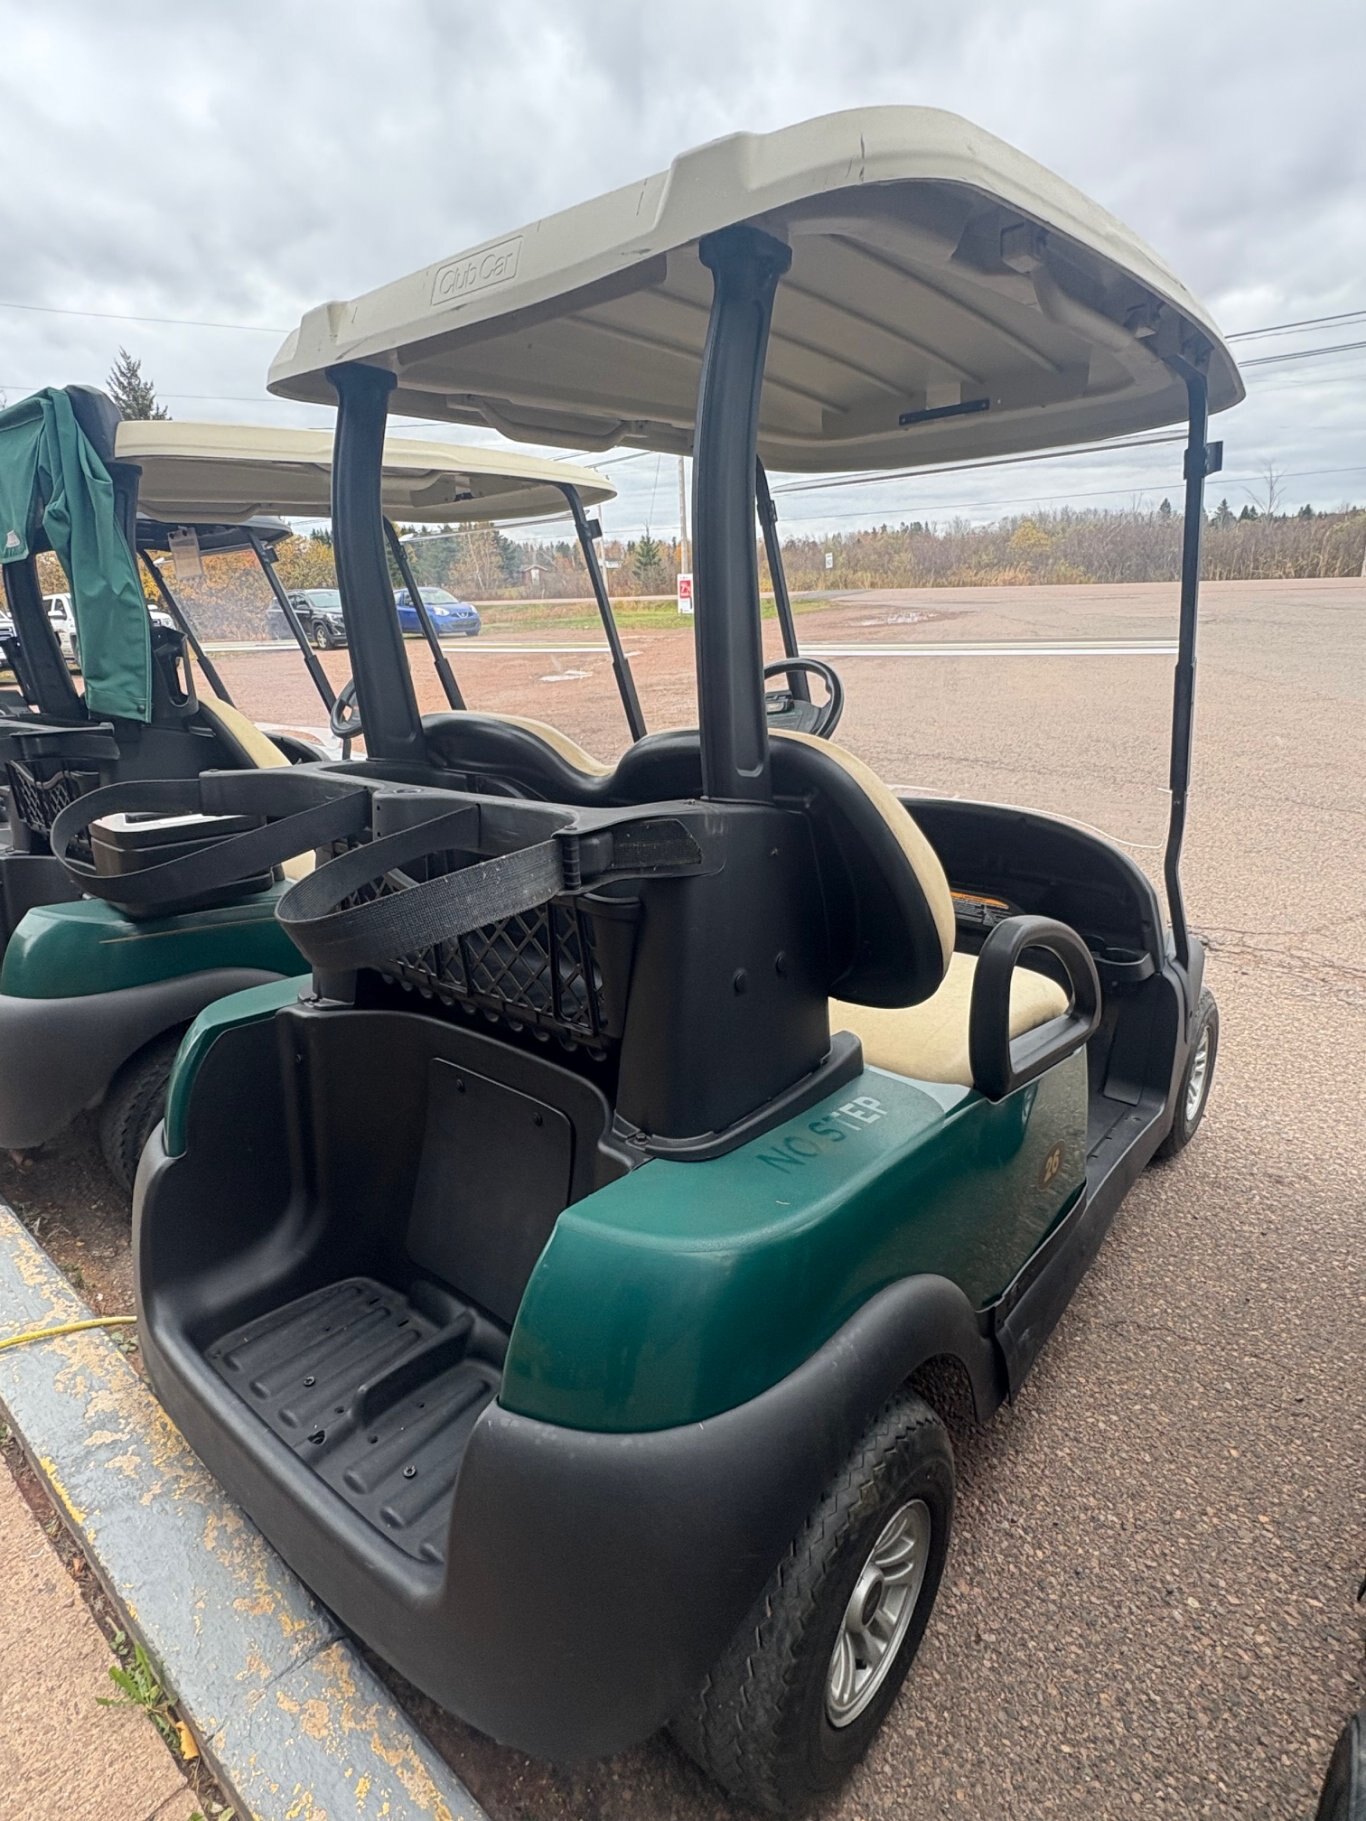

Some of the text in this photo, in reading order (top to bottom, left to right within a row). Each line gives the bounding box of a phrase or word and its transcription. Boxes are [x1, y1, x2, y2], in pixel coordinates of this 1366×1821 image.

[480, 252, 513, 280] Car
[755, 1096, 887, 1175] NO STEP
